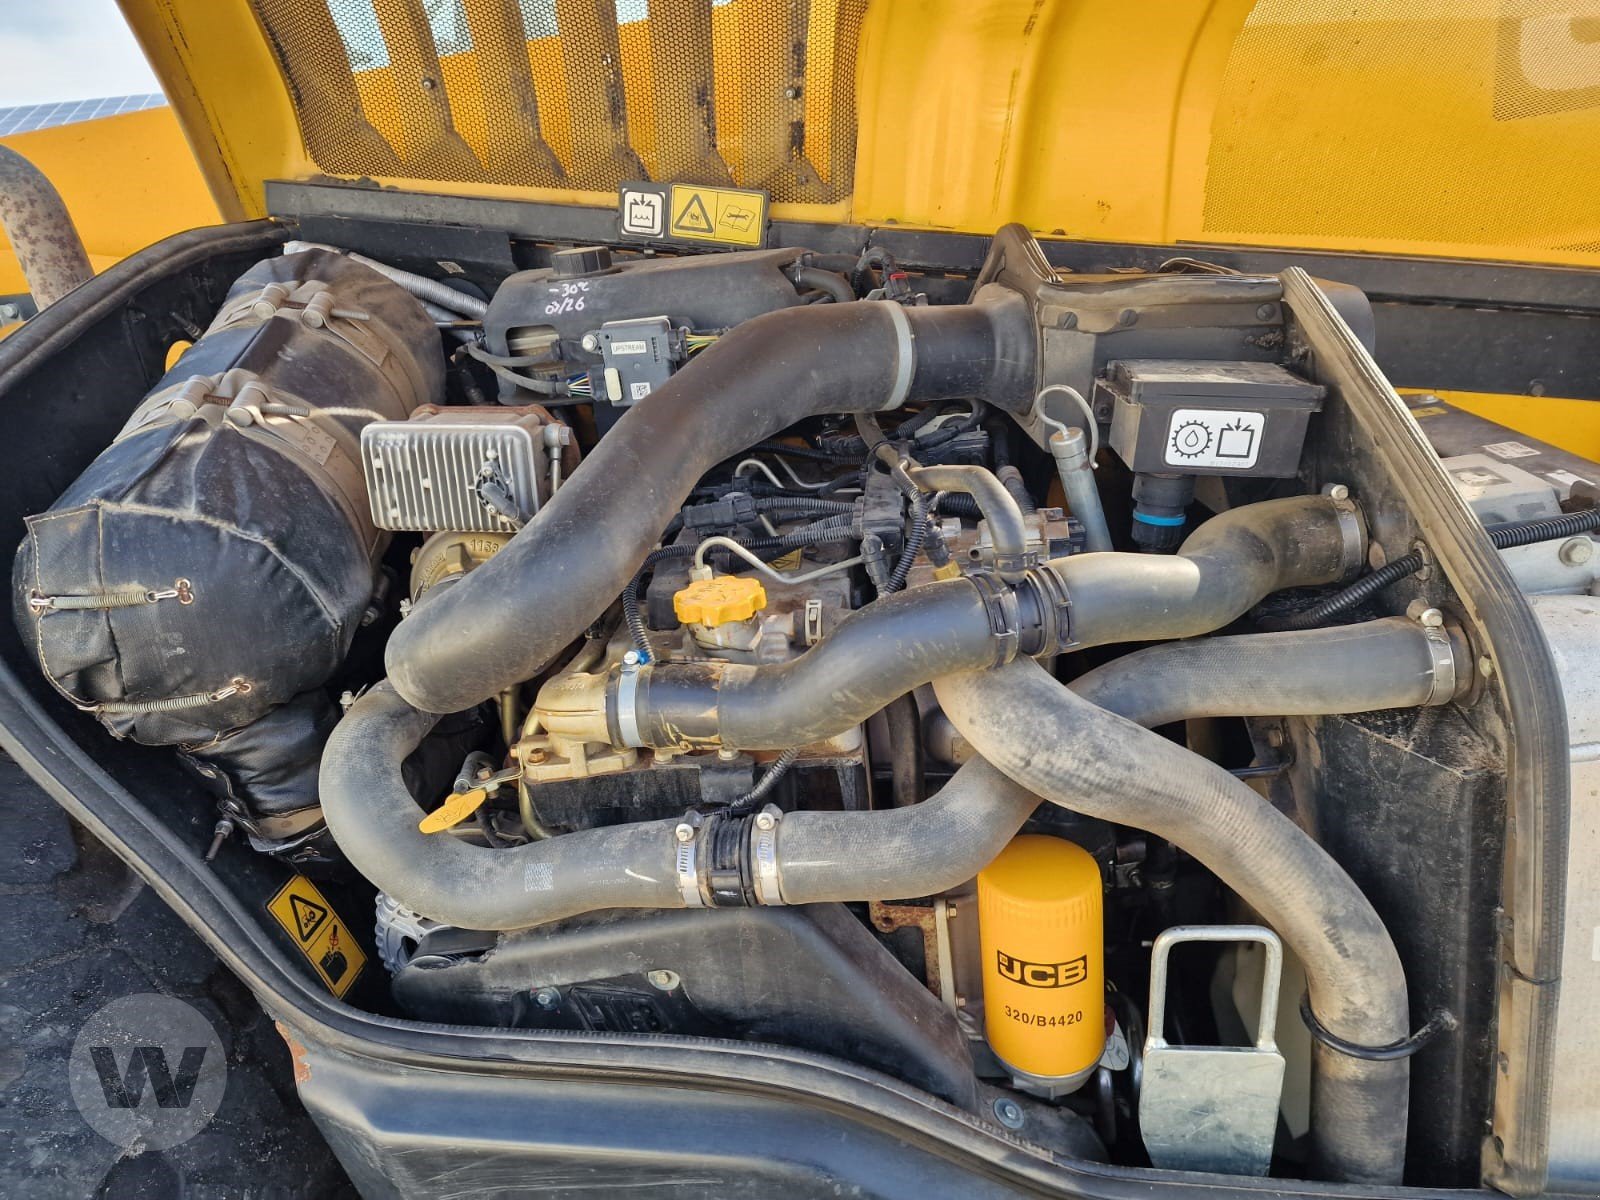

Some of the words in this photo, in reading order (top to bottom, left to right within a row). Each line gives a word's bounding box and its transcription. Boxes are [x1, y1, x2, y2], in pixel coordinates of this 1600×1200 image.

[612, 343, 646, 353] UPSTREAM
[998, 951, 1087, 988] JCB
[1004, 1005, 1083, 1027] 320/B4420
